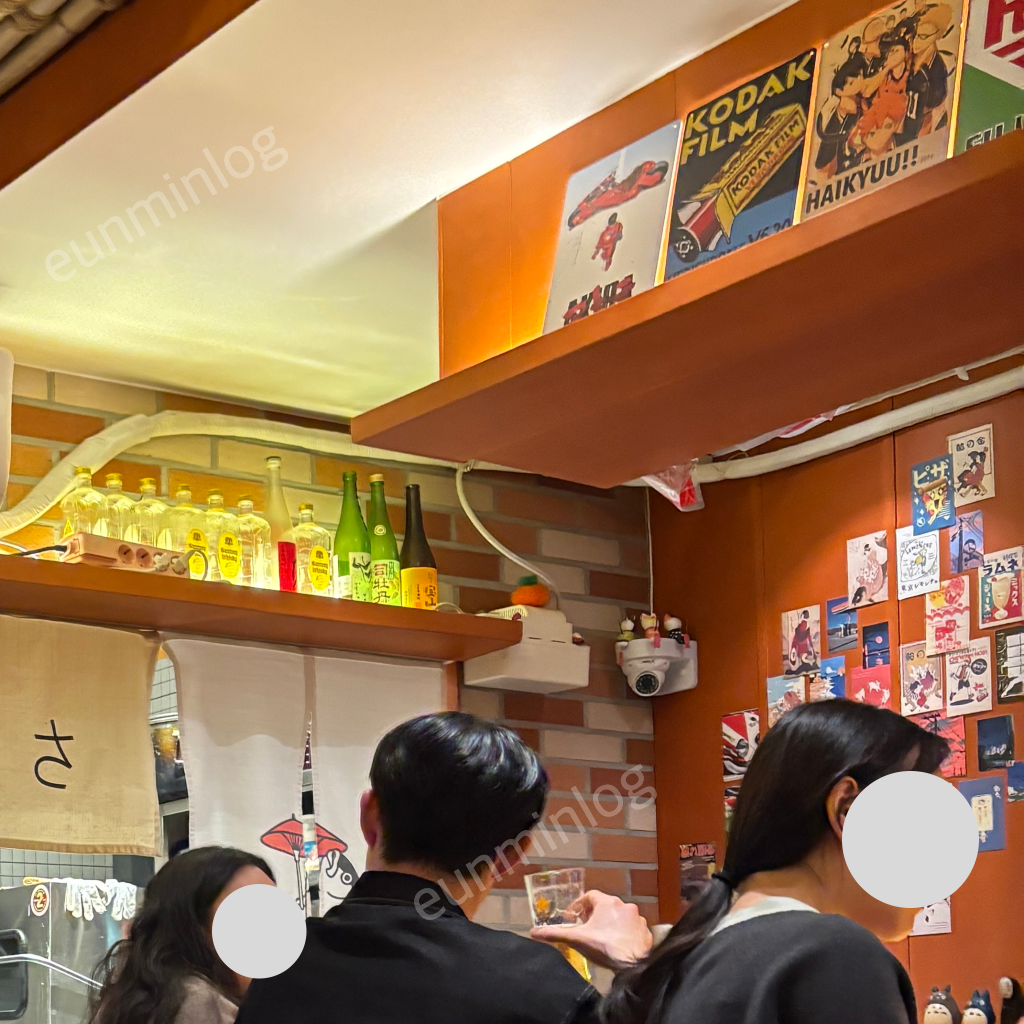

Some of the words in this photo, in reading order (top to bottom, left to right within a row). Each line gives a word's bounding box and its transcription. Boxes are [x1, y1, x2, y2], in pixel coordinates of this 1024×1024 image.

[685, 53, 813, 139] KODAK
[680, 108, 759, 165] FILM
[731, 150, 774, 195] KODAK
[774, 120, 800, 148] FILM
[805, 145, 919, 214] HAIKYUU!!
[913, 459, 949, 489] ピザ
[982, 559, 1019, 577] ラムネ
